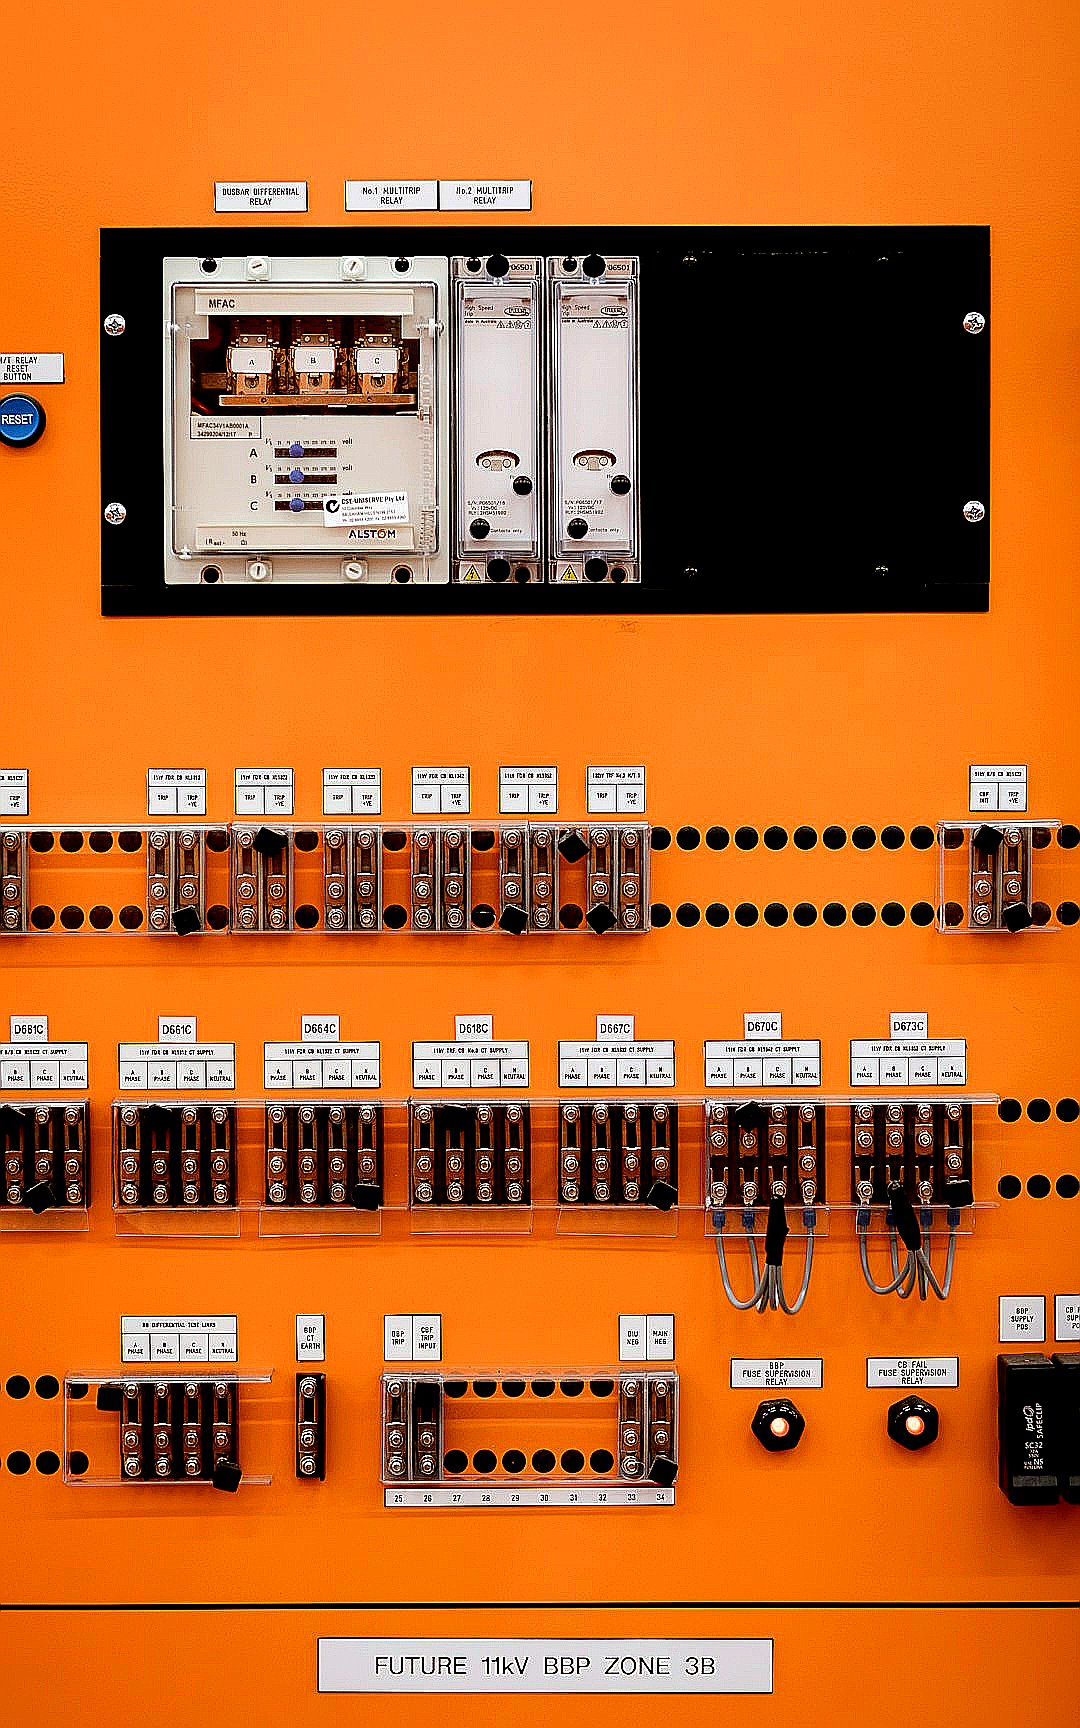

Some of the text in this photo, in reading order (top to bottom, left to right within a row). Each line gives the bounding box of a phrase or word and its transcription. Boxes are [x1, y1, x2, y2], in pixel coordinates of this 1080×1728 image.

[362, 186, 421, 195] No.1 MULTITRIP
[476, 186, 514, 195] MULTITRIP
[249, 197, 273, 206] RELAY
[380, 196, 403, 205] RELAY
[473, 196, 497, 205] RELAY
[208, 298, 236, 309] MFAC
[15, 356, 39, 365] RELAY
[3, 372, 32, 381] BUTTON
[1, 414, 34, 425] RESET
[249, 448, 258, 458] A
[250, 474, 257, 484] B
[250, 501, 258, 511] C
[347, 528, 397, 540] ALSTOM
[162, 1024, 192, 1035] D661C
[304, 1023, 336, 1034] D664C
[459, 1023, 489, 1034] D618C
[600, 1023, 631, 1034] D667C
[747, 1021, 778, 1032] D670C
[893, 1021, 924, 1032] D673C
[1065, 1306, 1074, 1315] CB
[1016, 1323, 1029, 1331] POS
[306, 1334, 315, 1342] CT
[391, 1338, 405, 1346] TRIP
[420, 1334, 434, 1342] TRIP
[300, 1342, 321, 1350] EARTH
[769, 1361, 785, 1370] BBP
[897, 1360, 928, 1369] CB FAIL
[742, 1369, 762, 1378] FUSE
[878, 1368, 898, 1377] FUSE
[765, 1377, 788, 1386] RELAY
[901, 1376, 924, 1385] RELAY
[1035, 1402, 1044, 1439] SAFECLIP
[1024, 1441, 1043, 1450] SC32
[394, 1493, 665, 1503] 25 26 27 28 29 30 31 32 33 34
[376, 1656, 714, 1674] FUTURE 11kV BBP ZONE 3B
